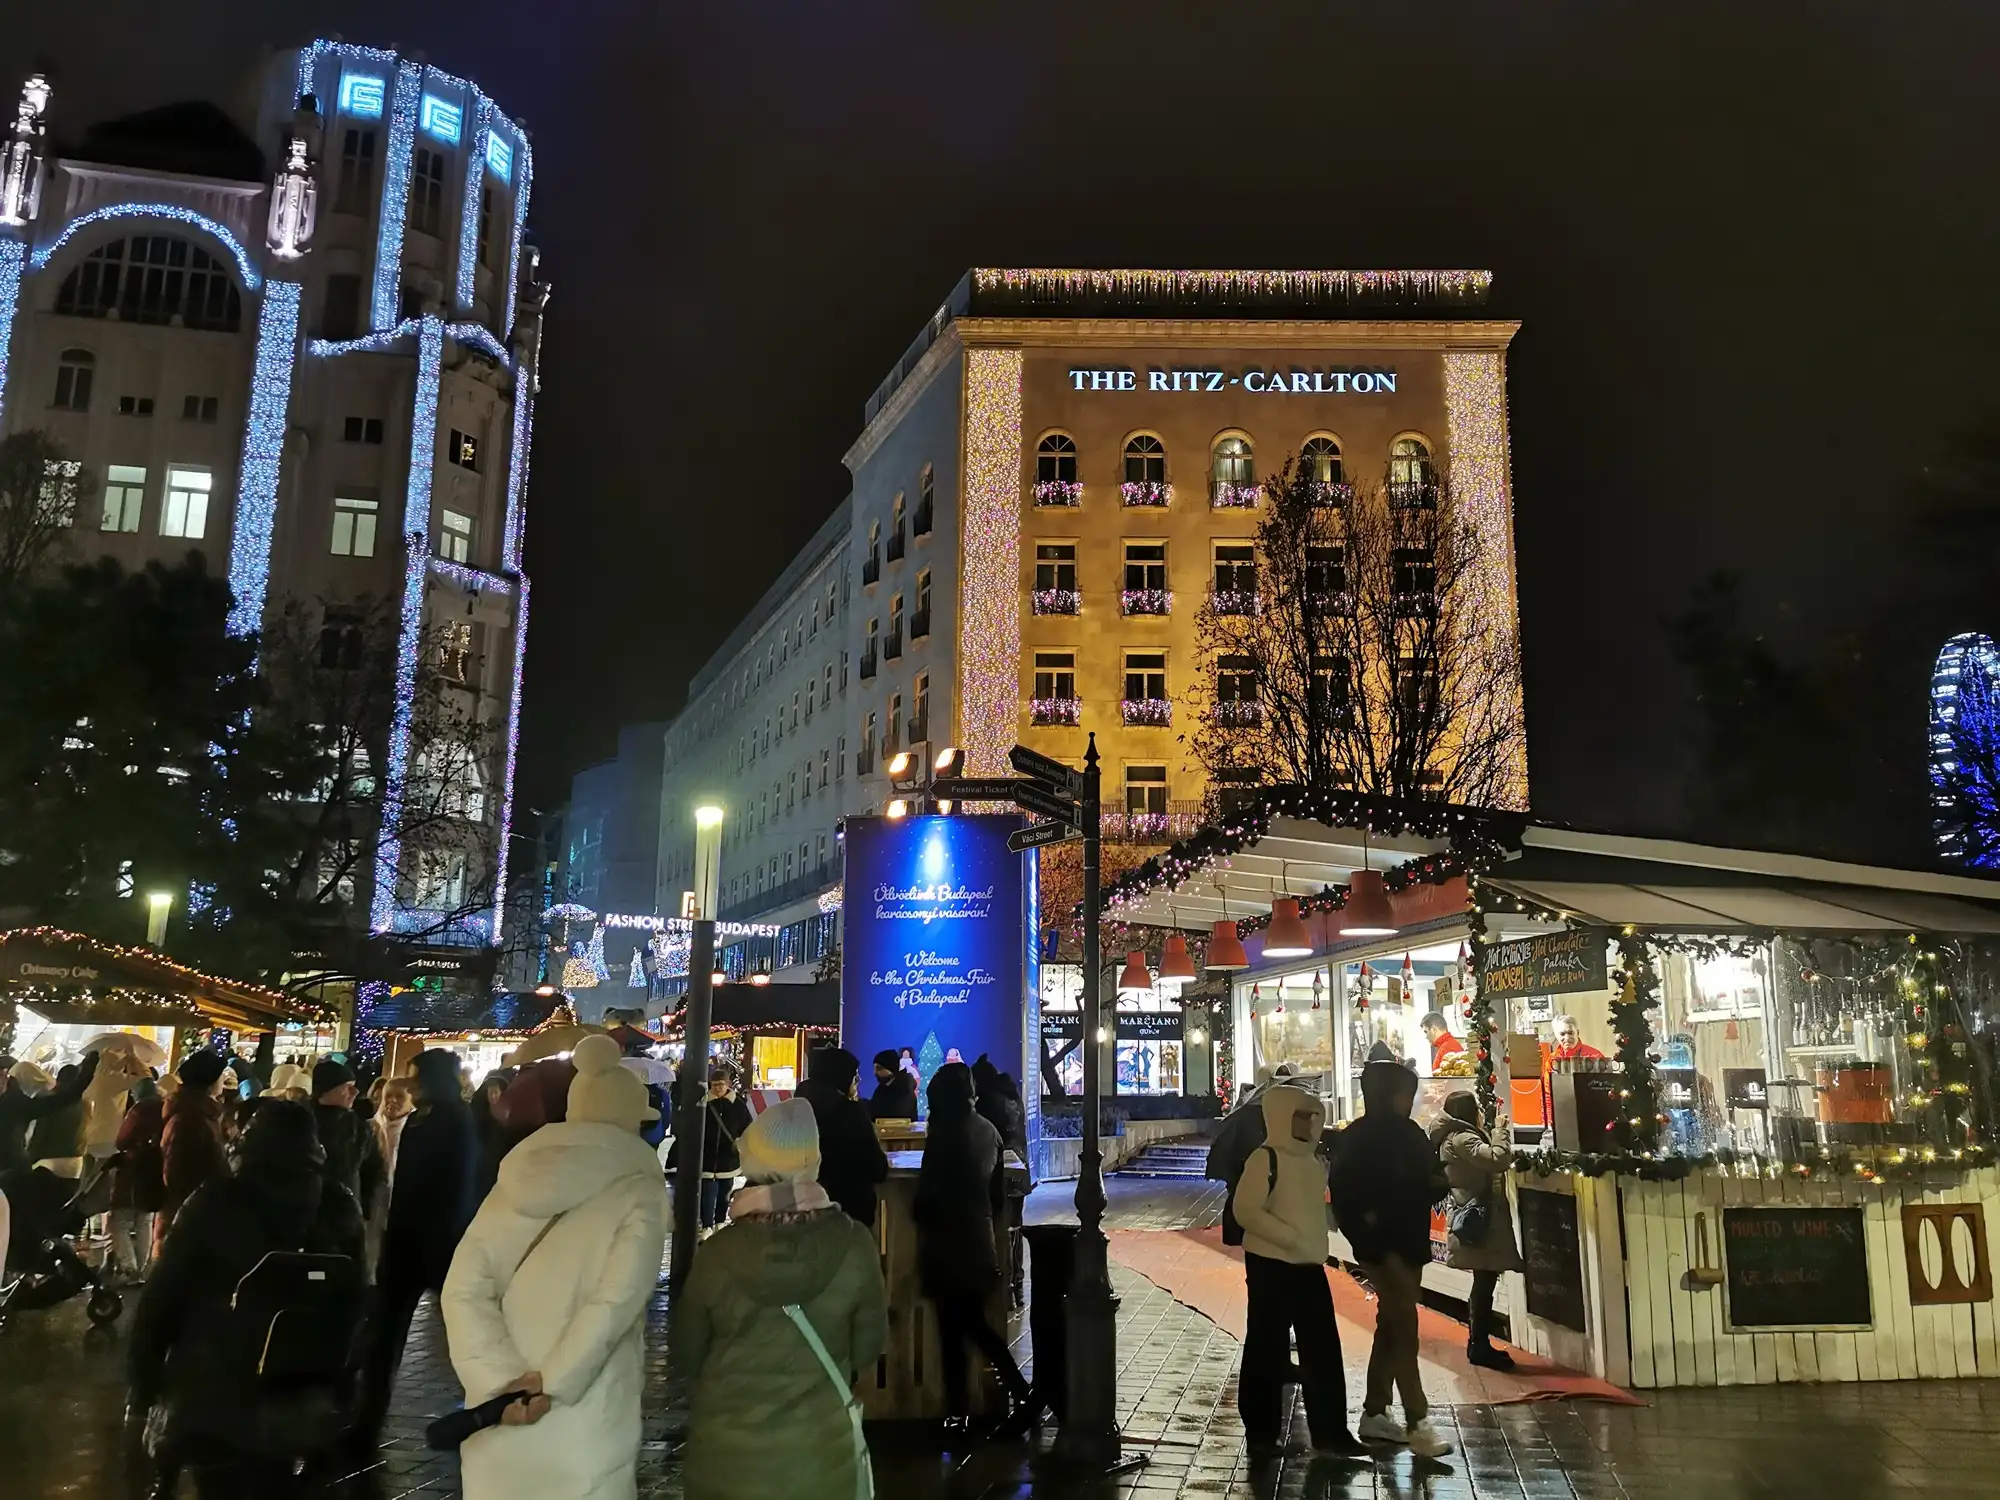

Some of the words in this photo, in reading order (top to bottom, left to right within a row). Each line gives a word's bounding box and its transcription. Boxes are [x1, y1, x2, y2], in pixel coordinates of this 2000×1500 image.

[1069, 370, 1137, 391] THE
[1148, 371, 1397, 393] RITZ-CARLTON
[951, 785, 982, 793] Festival
[984, 785, 1008, 793] Ticket
[1021, 831, 1034, 843] Váci
[1035, 829, 1053, 840] Street
[937, 883, 994, 903] Budapest
[876, 904, 938, 924] karácsonyi
[938, 903, 991, 918] vásárán!
[605, 913, 665, 930] FASHION
[667, 917, 694, 931] STR
[714, 921, 781, 937] BUDAPEST
[1532, 938, 1547, 962] Hot
[1548, 932, 1591, 953] Chocolate
[904, 950, 960, 967] Welcome
[870, 971, 883, 985] to
[884, 970, 903, 985] the
[905, 970, 967, 986] Christmas
[967, 969, 995, 985] Fair
[894, 990, 907, 1008] of
[908, 989, 970, 1008] Budapest!
[1040, 1015, 1079, 1024] RCIAN
[1119, 1016, 1179, 1026] MARCIANO
